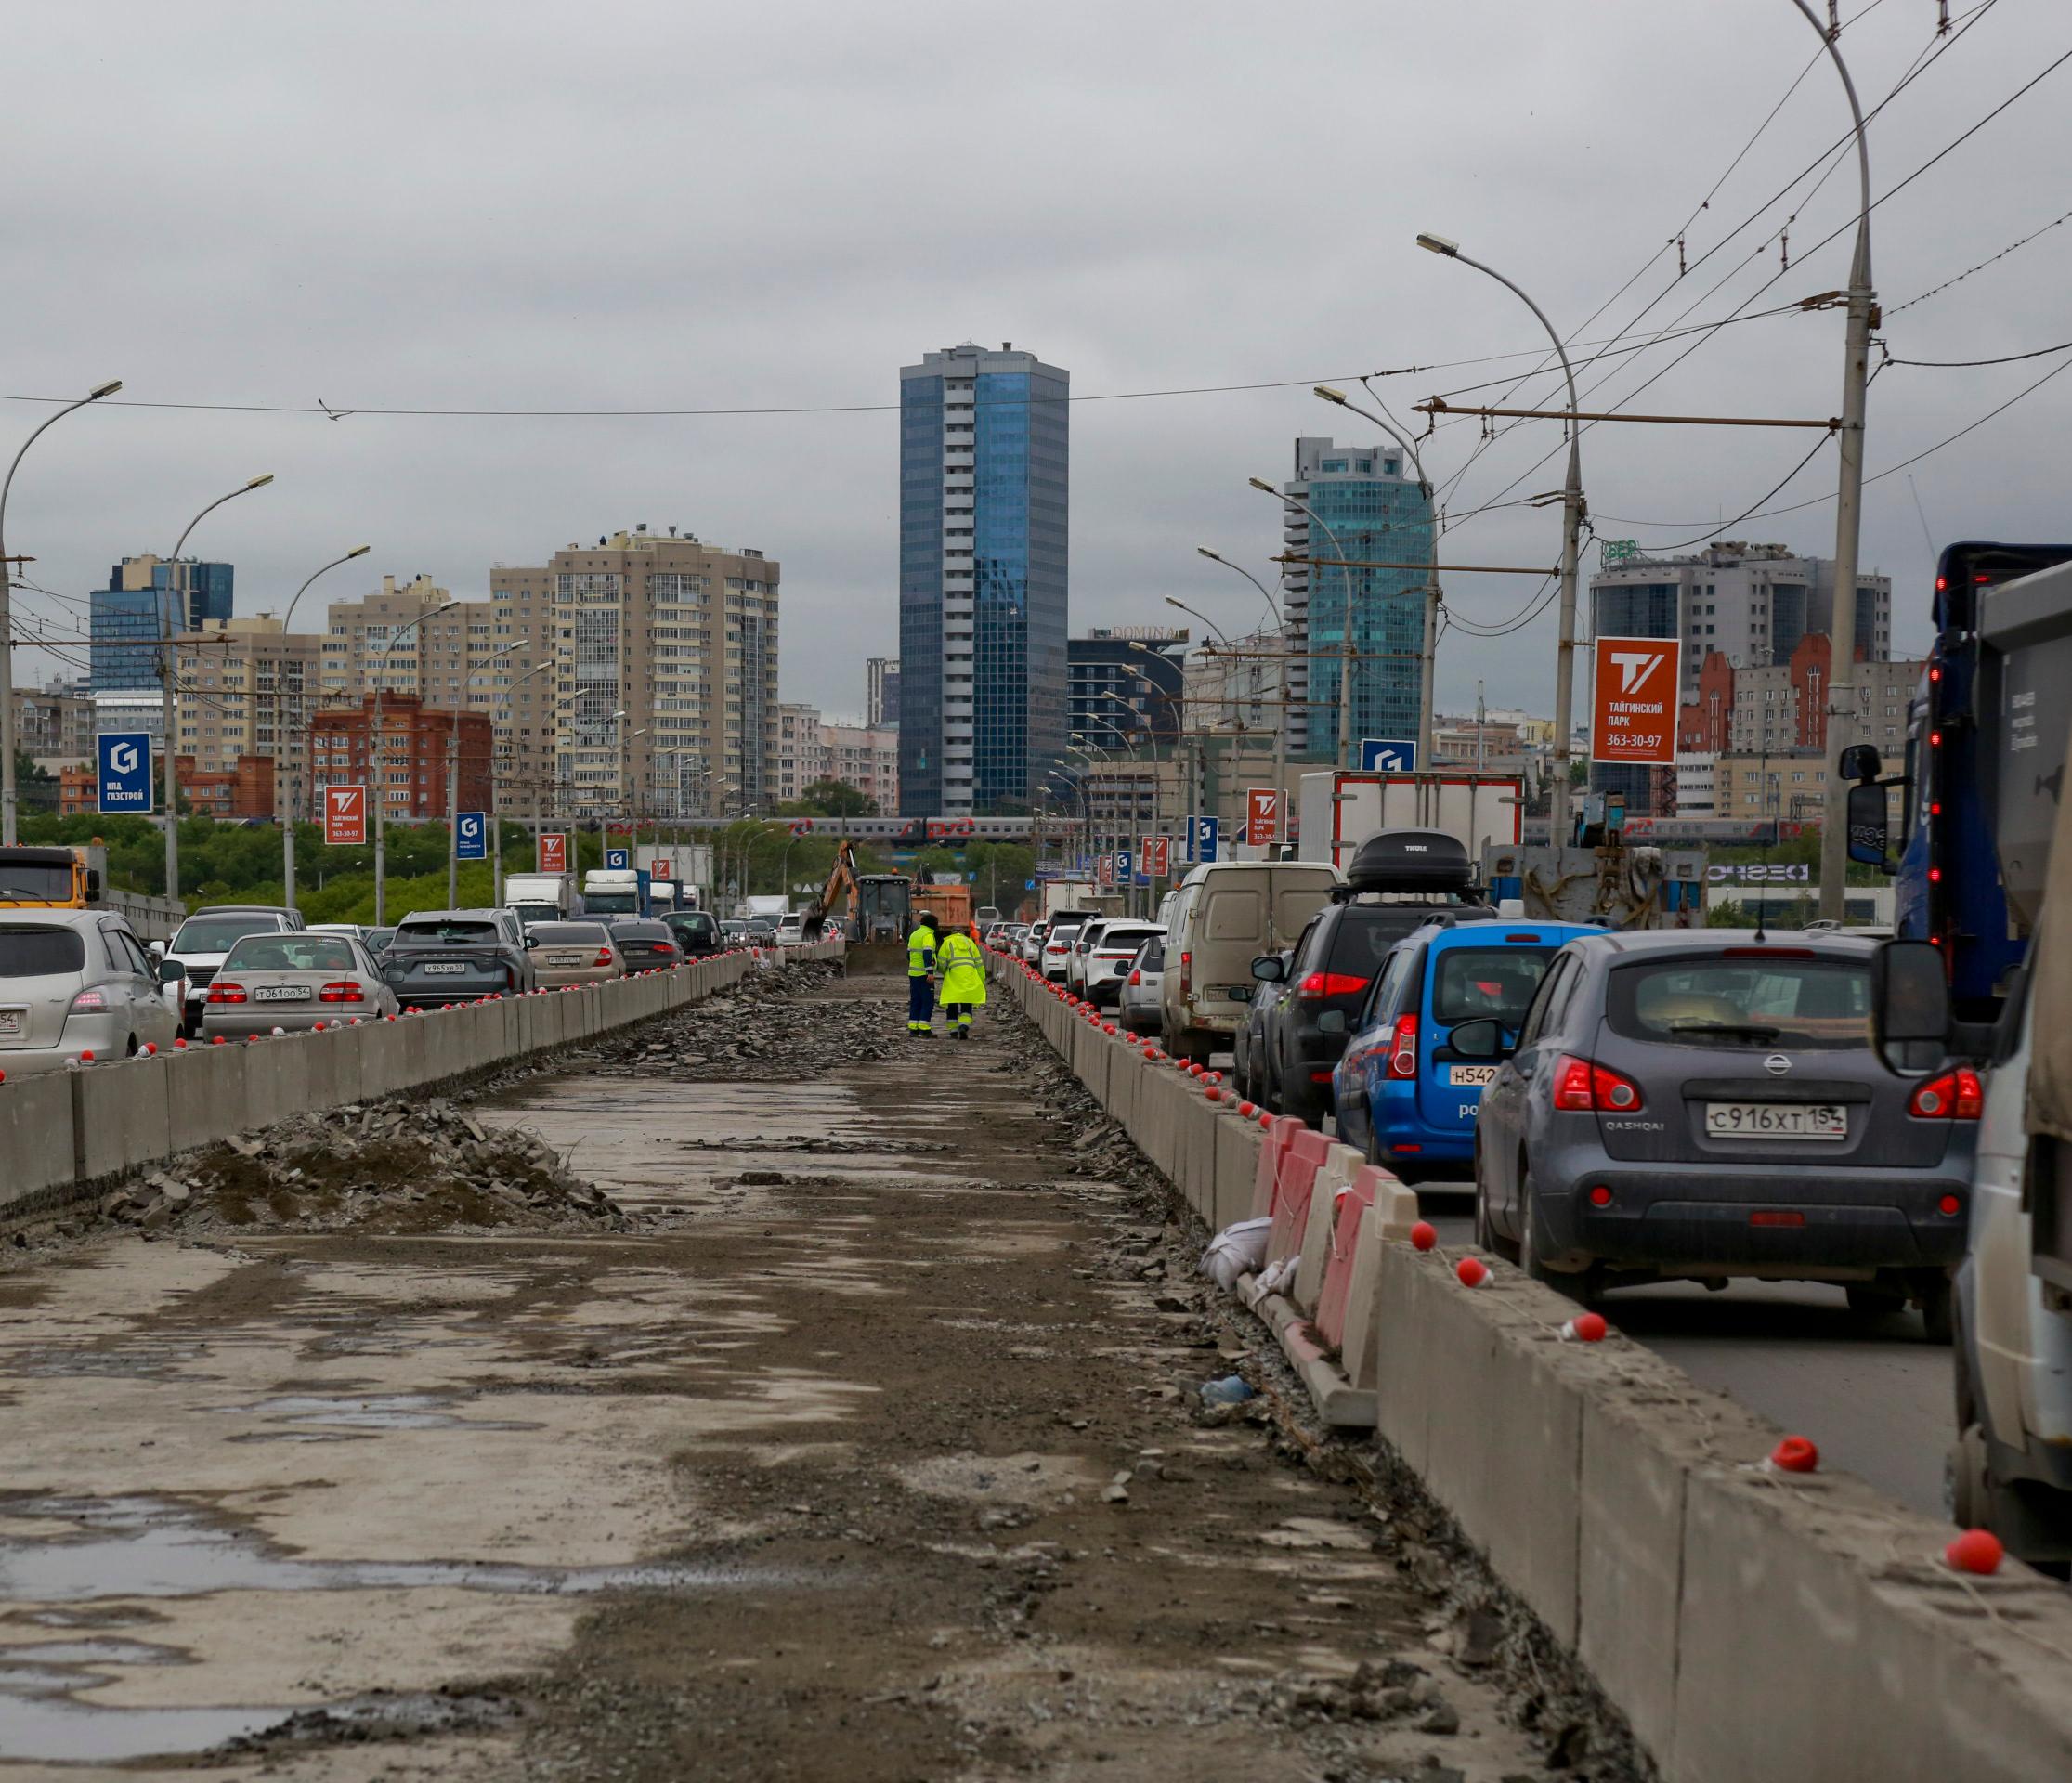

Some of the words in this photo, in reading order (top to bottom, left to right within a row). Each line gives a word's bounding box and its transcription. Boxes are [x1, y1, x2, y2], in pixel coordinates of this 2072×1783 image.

[1114, 626, 1177, 640] DOMINA
[1609, 701, 1663, 714] ТАЙГИНСКИЙ
[1608, 716, 1630, 726] ПАРК
[1606, 734, 1662, 747] 363-30-97
[107, 789, 144, 800] ГАЗСТРОЙ
[1606, 1120, 1664, 1131] QASHQAI
[1714, 1108, 1802, 1130] С916ХТ
